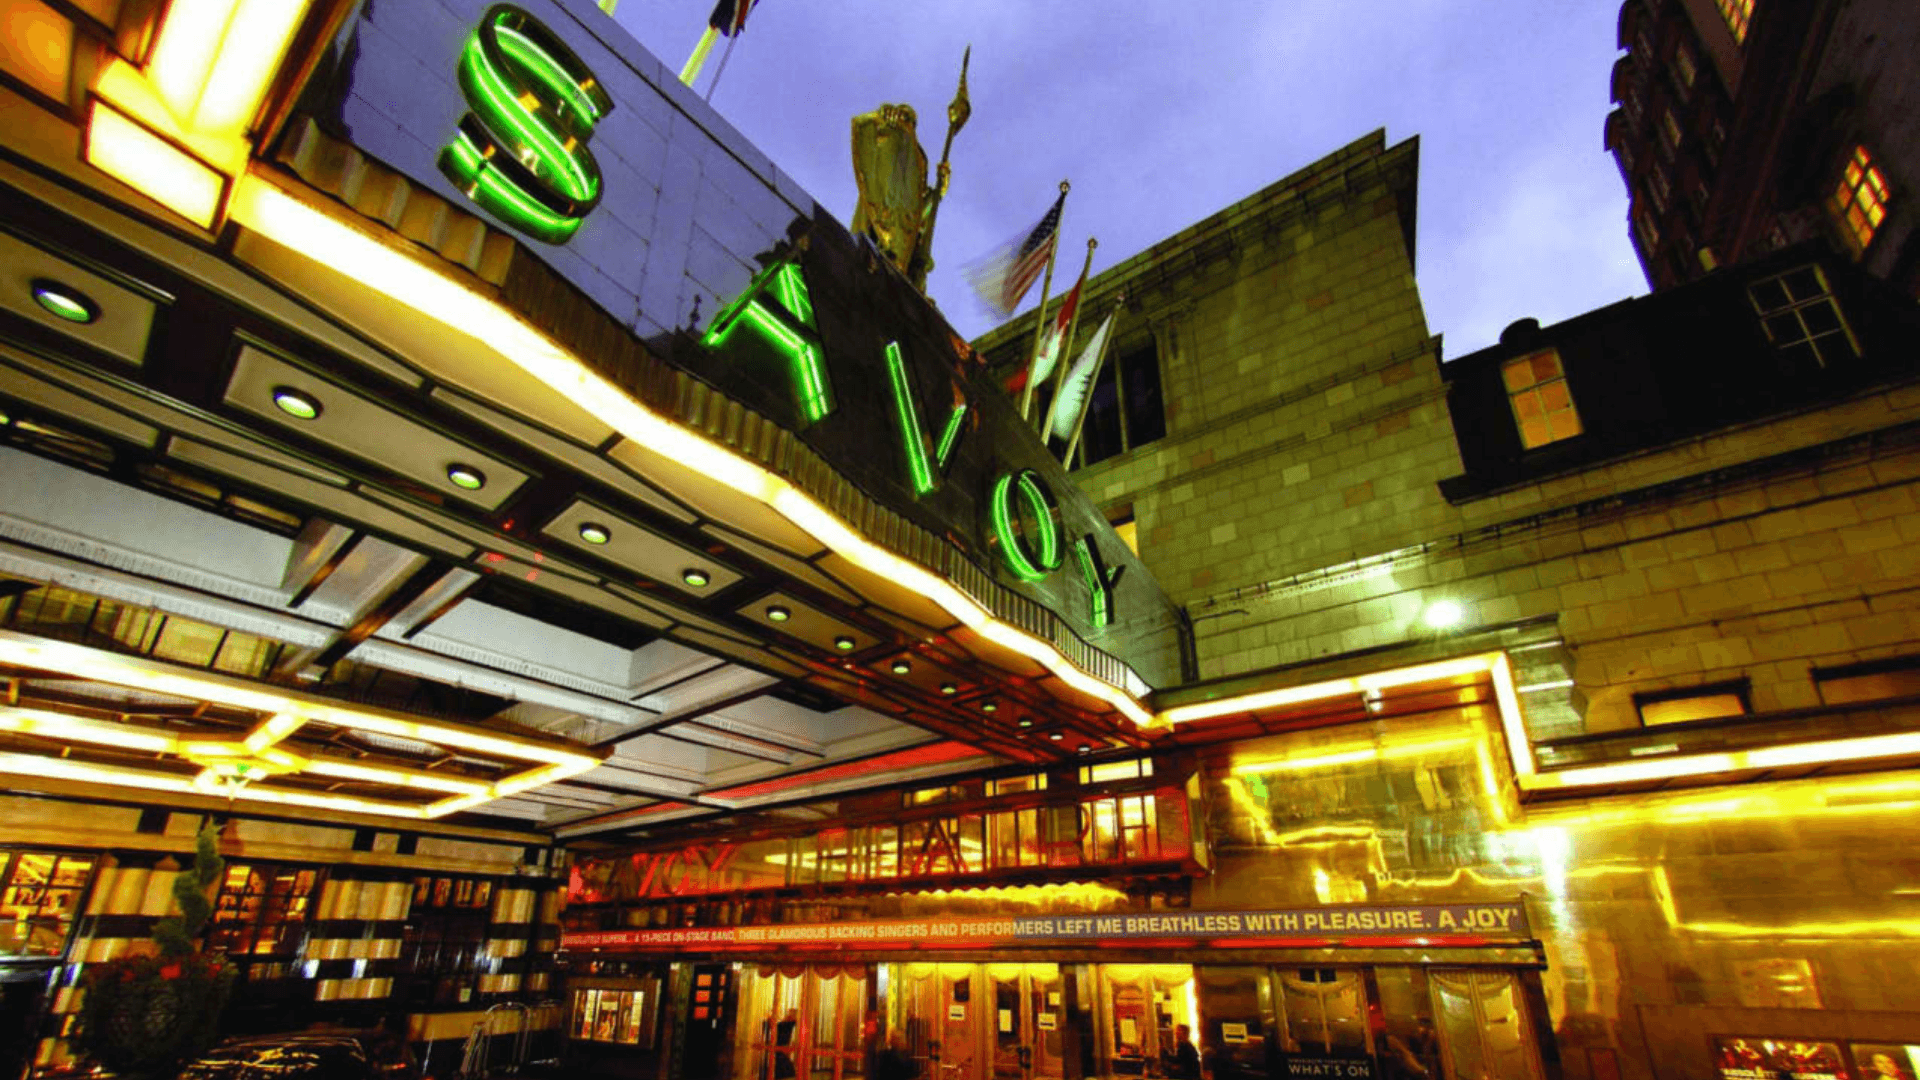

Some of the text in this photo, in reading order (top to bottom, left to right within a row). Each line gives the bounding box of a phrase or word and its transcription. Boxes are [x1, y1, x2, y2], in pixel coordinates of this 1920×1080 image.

[438, 3, 1126, 628] SAVOY
[767, 926, 827, 940] GLAMOROUS
[828, 924, 874, 939] BACKING
[875, 923, 927, 938] SINGERS
[929, 922, 957, 937] AND
[959, 919, 1052, 937] PERFORMERS
[1055, 918, 1093, 935] LEFT
[1095, 917, 1121, 934] ME
[1126, 915, 1242, 934] BREATHLESS
[1244, 913, 1299, 932] WITH
[1303, 910, 1432, 930] PLEASURE.
[1438, 909, 1458, 929] A
[1288, 1063, 1370, 1077] WHAT'S ON
